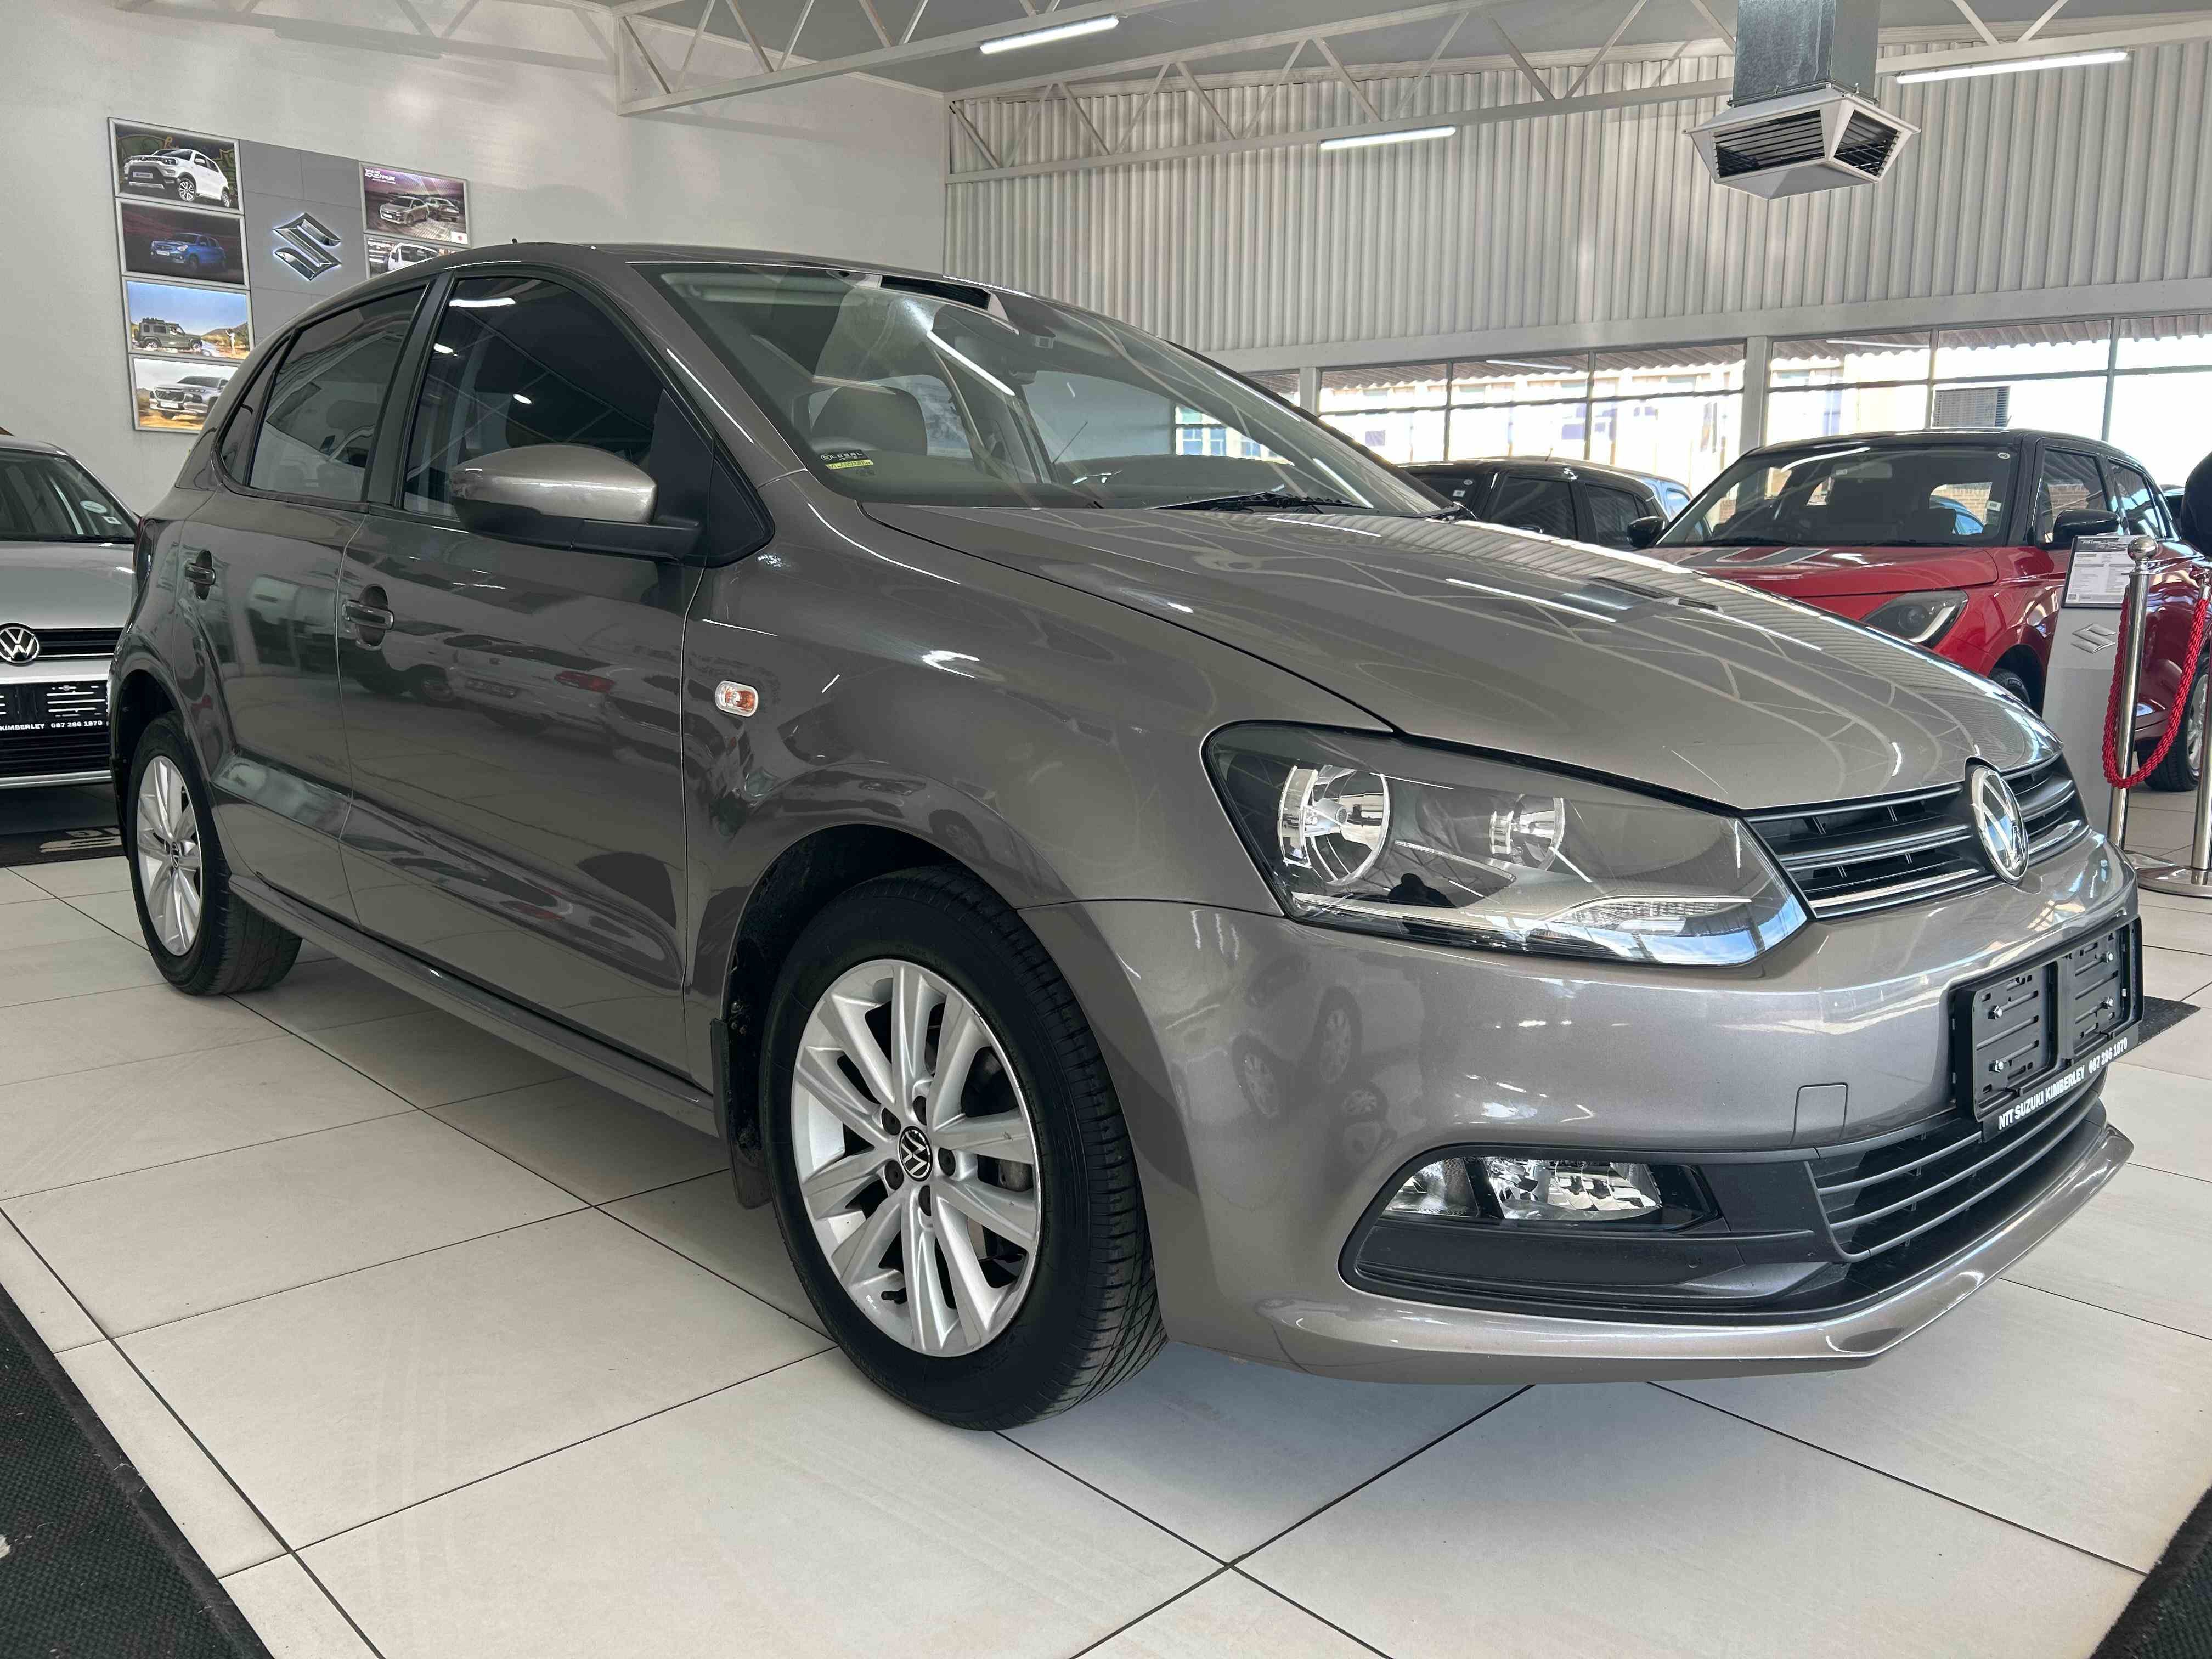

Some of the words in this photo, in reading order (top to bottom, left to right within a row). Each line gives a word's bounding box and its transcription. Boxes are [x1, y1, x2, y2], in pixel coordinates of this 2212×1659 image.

[1999, 1109, 2014, 1130] NTT
[2015, 1091, 2044, 1120] SUZUKI
[2045, 1065, 2085, 1102] KIMBERLEY
[2089, 1055, 2100, 1074] 087
[2101, 1047, 2112, 1065] 286
[2113, 1037, 2128, 1057] 1870
